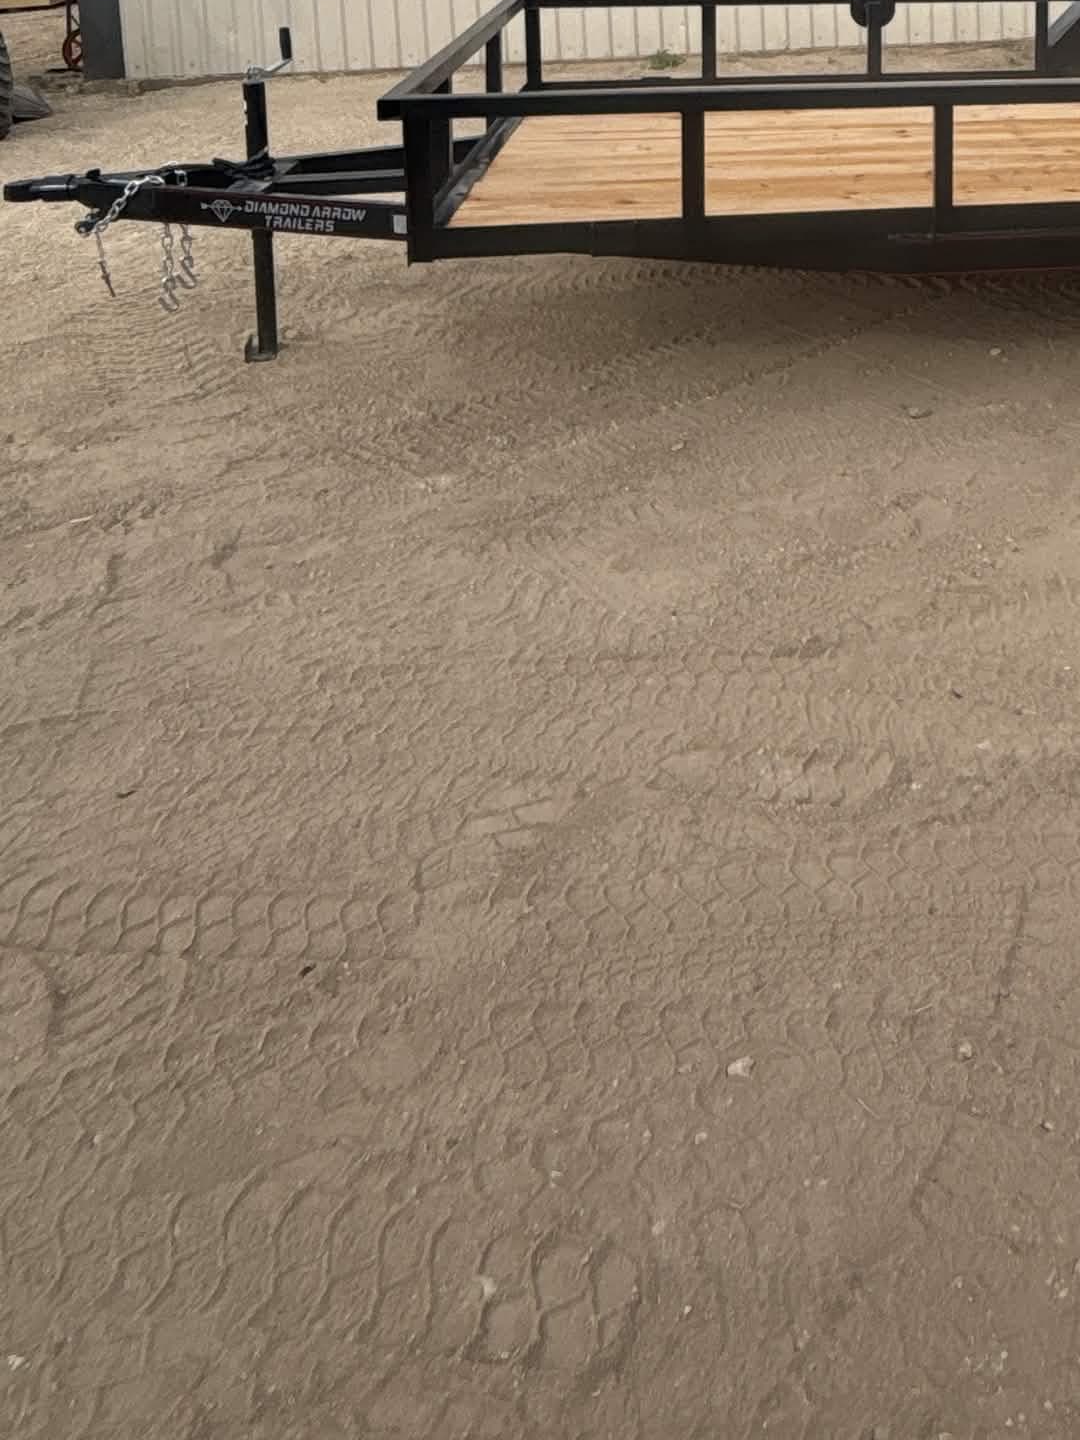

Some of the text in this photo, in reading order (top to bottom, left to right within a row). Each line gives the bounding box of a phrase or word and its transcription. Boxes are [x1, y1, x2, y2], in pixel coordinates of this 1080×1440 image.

[244, 200, 366, 222] DIAMOND ARROW
[264, 215, 335, 233] TRAILERS
